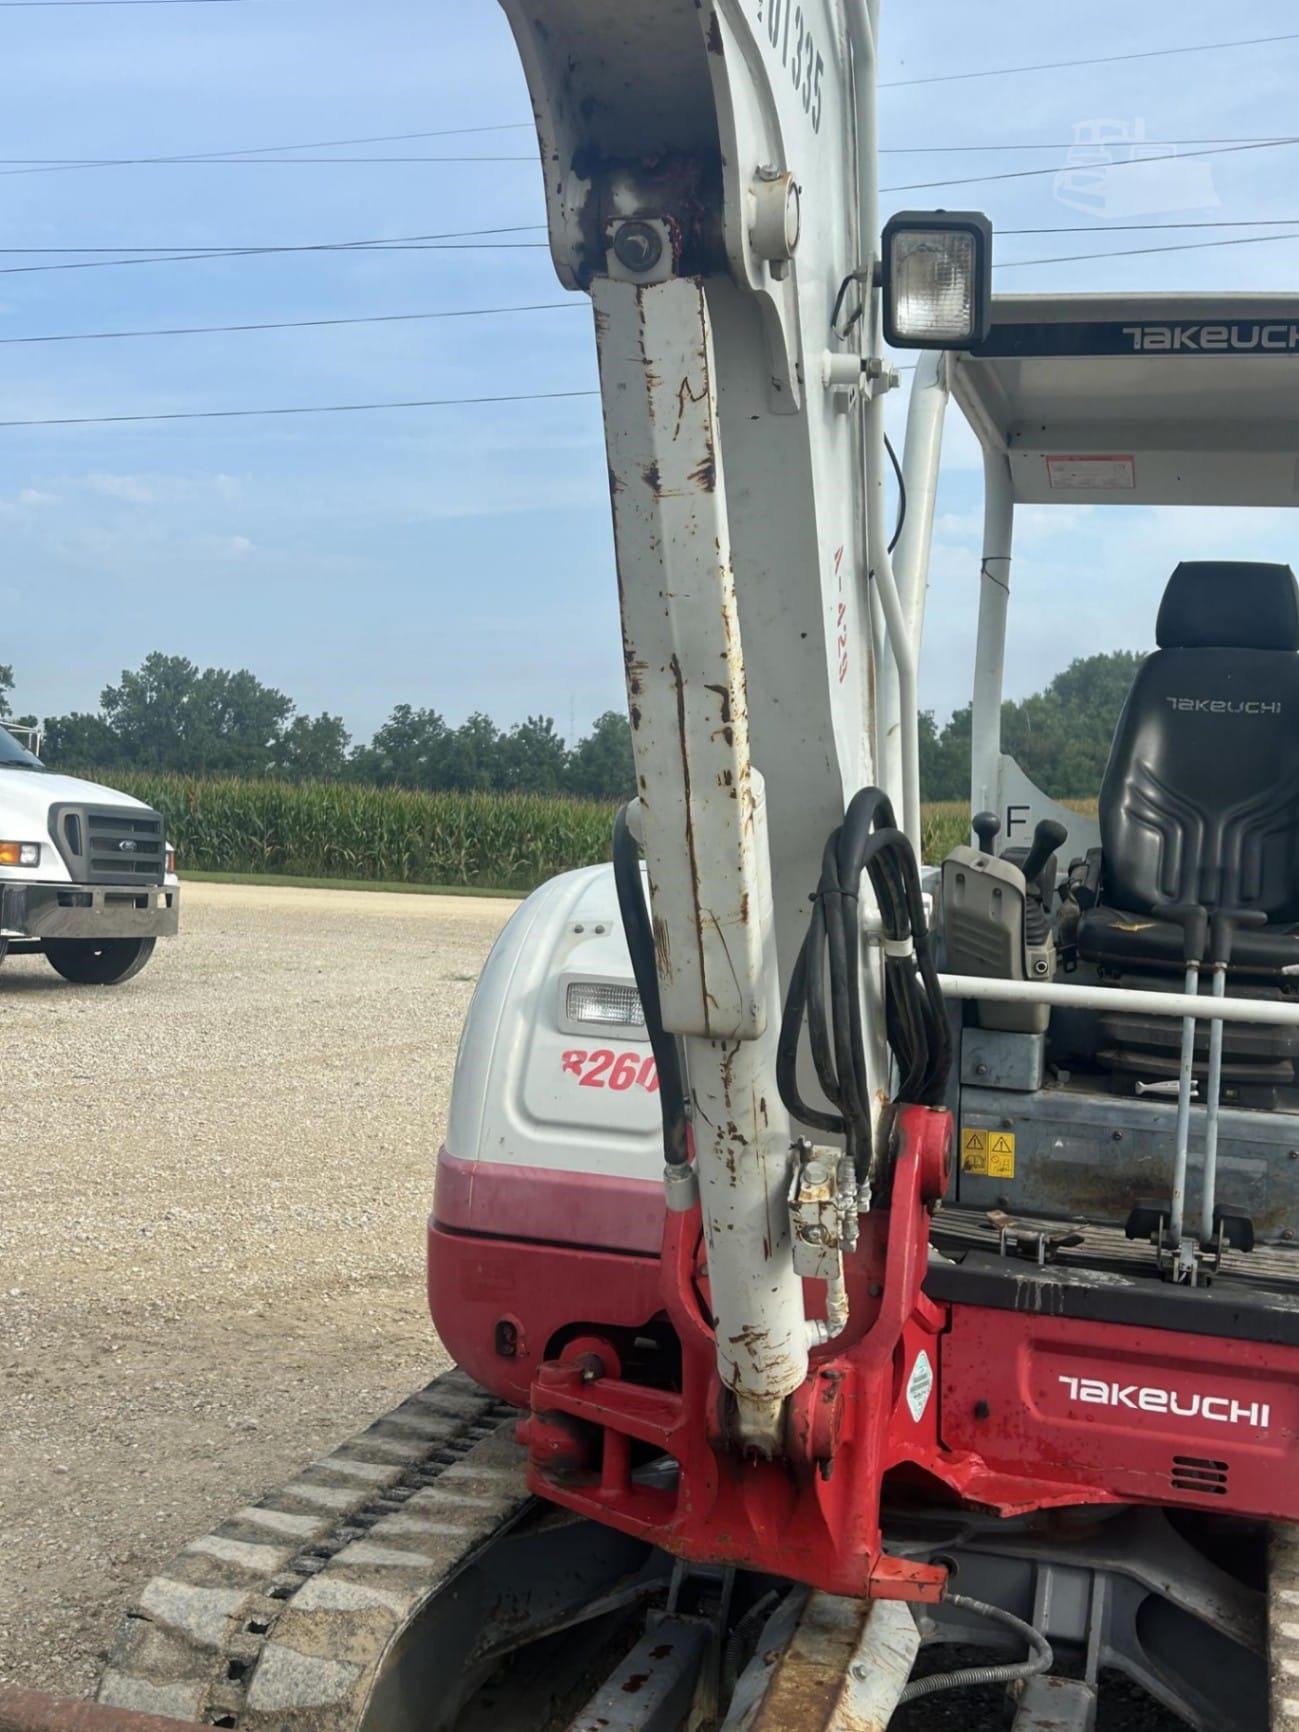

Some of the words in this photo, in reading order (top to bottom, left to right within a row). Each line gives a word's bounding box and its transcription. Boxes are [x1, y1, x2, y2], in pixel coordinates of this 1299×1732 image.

[1165, 696, 1282, 714] TAKEUCHI
[1006, 805, 1031, 838] F
[1058, 1375, 1271, 1428] TAKEUCHI
